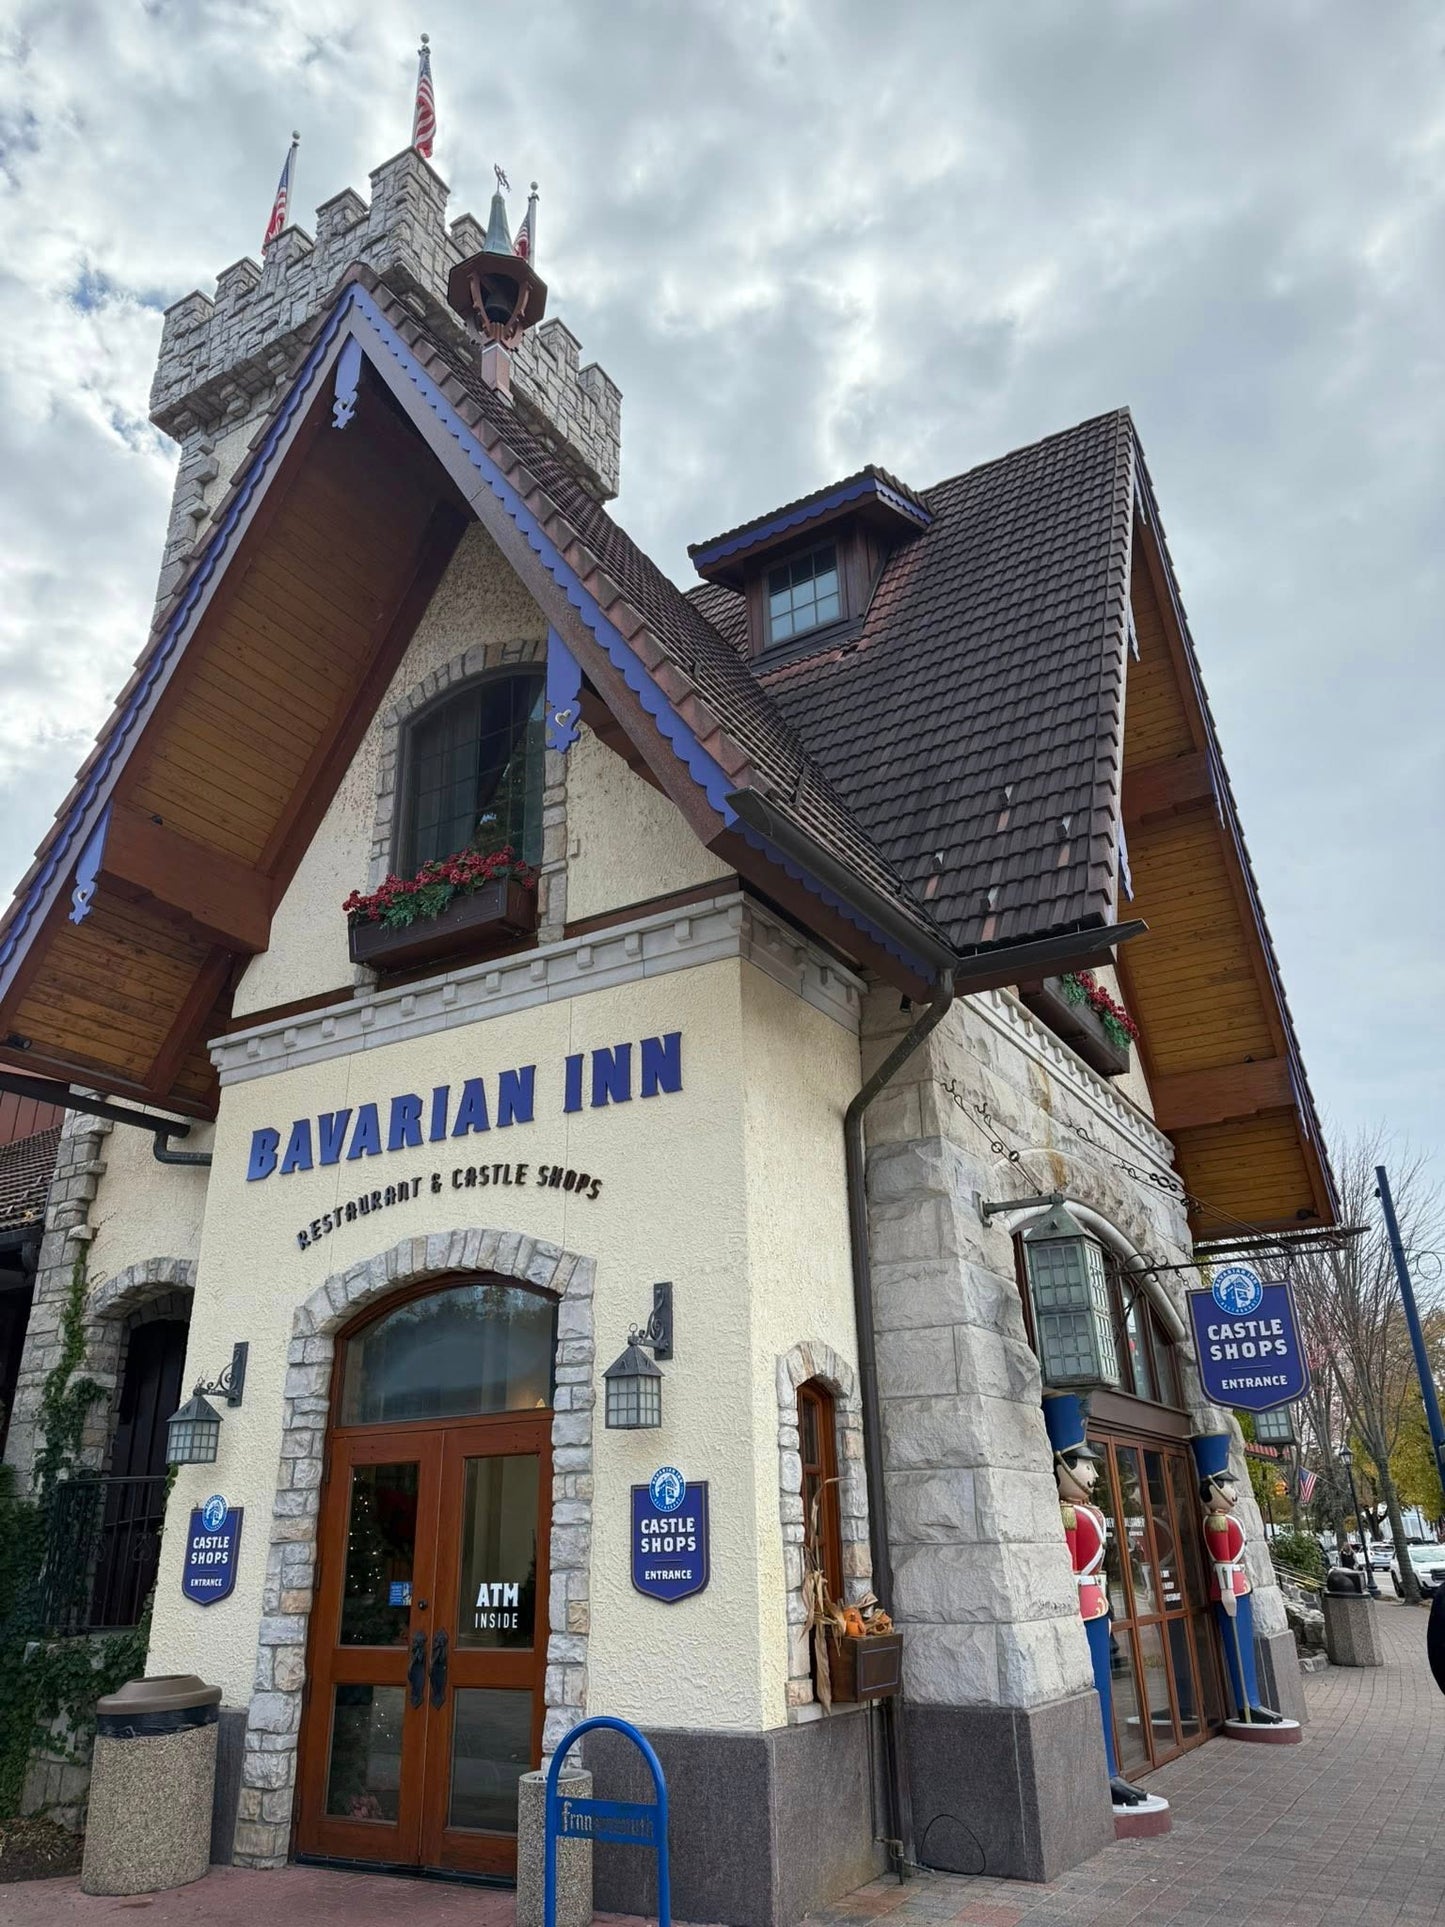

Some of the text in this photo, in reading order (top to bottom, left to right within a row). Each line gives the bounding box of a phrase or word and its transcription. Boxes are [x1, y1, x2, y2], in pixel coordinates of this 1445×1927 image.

[246, 1031, 684, 1182] BAVARIAN INN
[295, 1163, 604, 1251] RESTAURANT & CASTLE SHOPS
[1207, 1318, 1284, 1341] CASTLE
[1210, 1339, 1288, 1361] SHOPS
[1221, 1375, 1288, 1390] ENTRANCE
[641, 1517, 695, 1534] CASTLE
[193, 1536, 230, 1549] CASTLE
[641, 1536, 696, 1553] SHOPS
[190, 1551, 229, 1565] SHOPS
[190, 1578, 223, 1587] ENTRANCE
[645, 1569, 692, 1580] ENTRANCE
[476, 1583, 519, 1607] ATM
[475, 1612, 518, 1629] INSIDE
